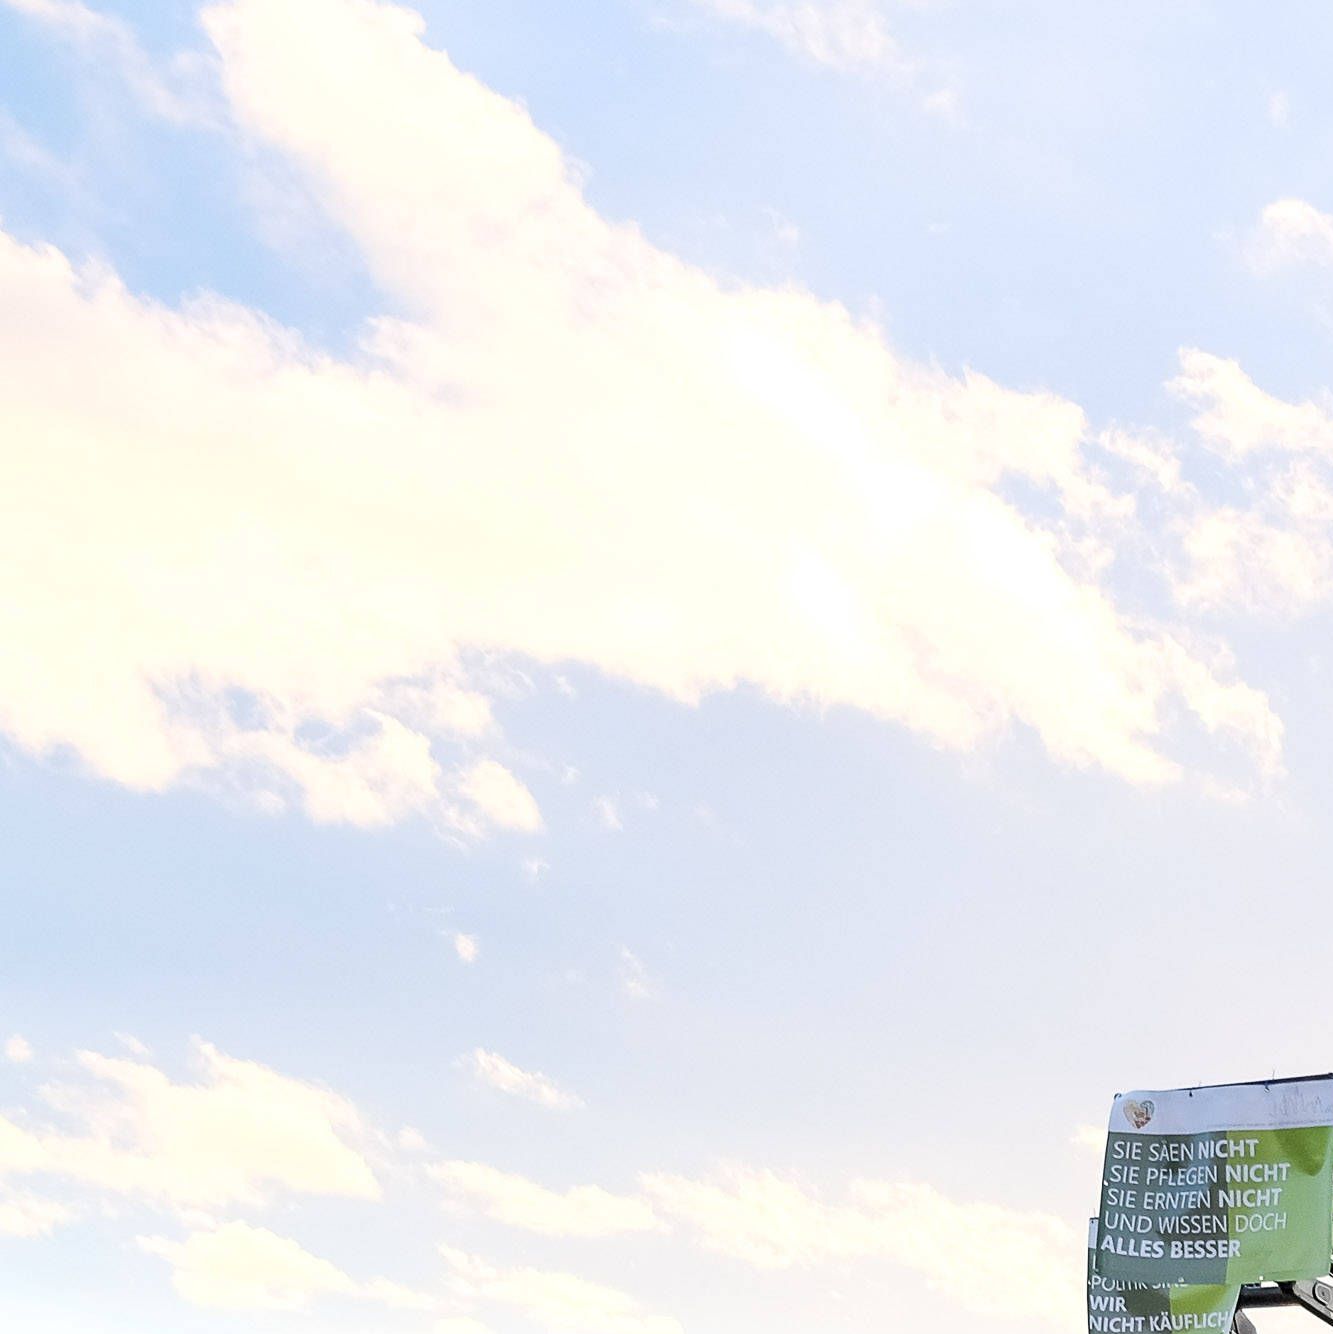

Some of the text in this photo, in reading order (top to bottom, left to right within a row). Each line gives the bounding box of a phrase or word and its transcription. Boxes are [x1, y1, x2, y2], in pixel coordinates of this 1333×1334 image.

[1112, 1138, 1259, 1162] SIE SÄEN NICHT
[1109, 1162, 1291, 1187] SIE PFLEGEN NICHT
[1106, 1187, 1283, 1210] SIE ERNTEN NICHT
[1104, 1210, 1287, 1235] UND WISSEN DOCH
[1100, 1234, 1242, 1259] ALLES BESSER
[1089, 1294, 1128, 1313] WIR
[1089, 1310, 1229, 1334] NICHT KÄUFLICH
